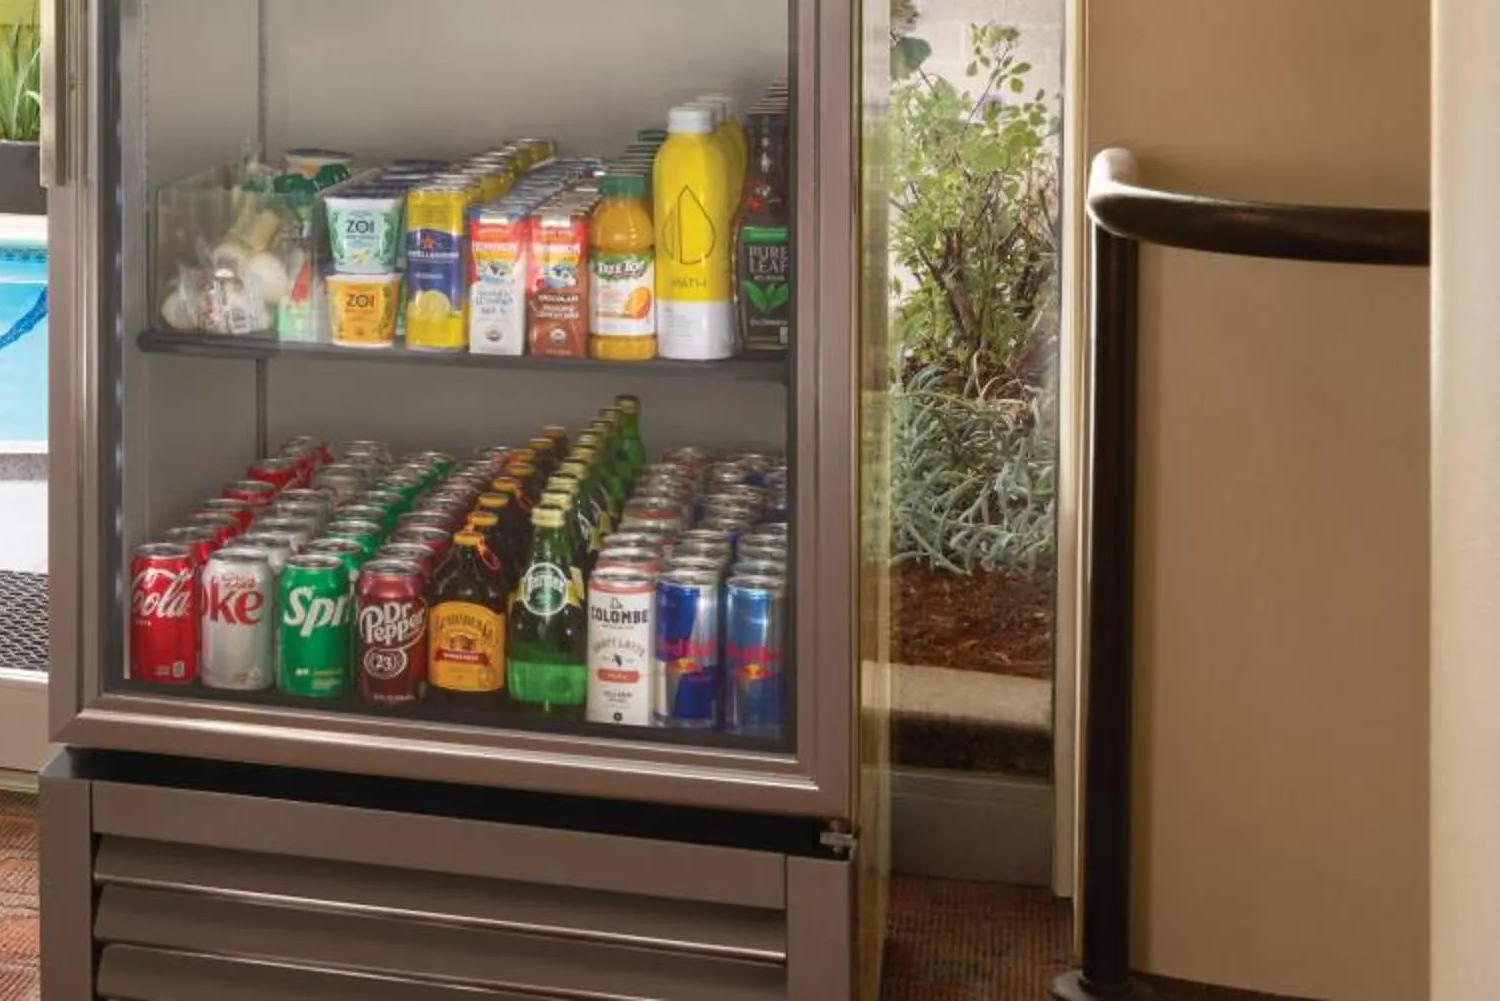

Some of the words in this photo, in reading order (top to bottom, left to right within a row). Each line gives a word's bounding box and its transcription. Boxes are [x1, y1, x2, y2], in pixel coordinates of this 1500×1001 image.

[346, 220, 376, 234] ZOI
[749, 246, 788, 259] PURE
[345, 294, 375, 308] ZOI
[384, 602, 413, 623] Dr
[591, 605, 648, 624] COLOMBE
[360, 605, 425, 646] Pepper
[374, 655, 393, 672] 23
